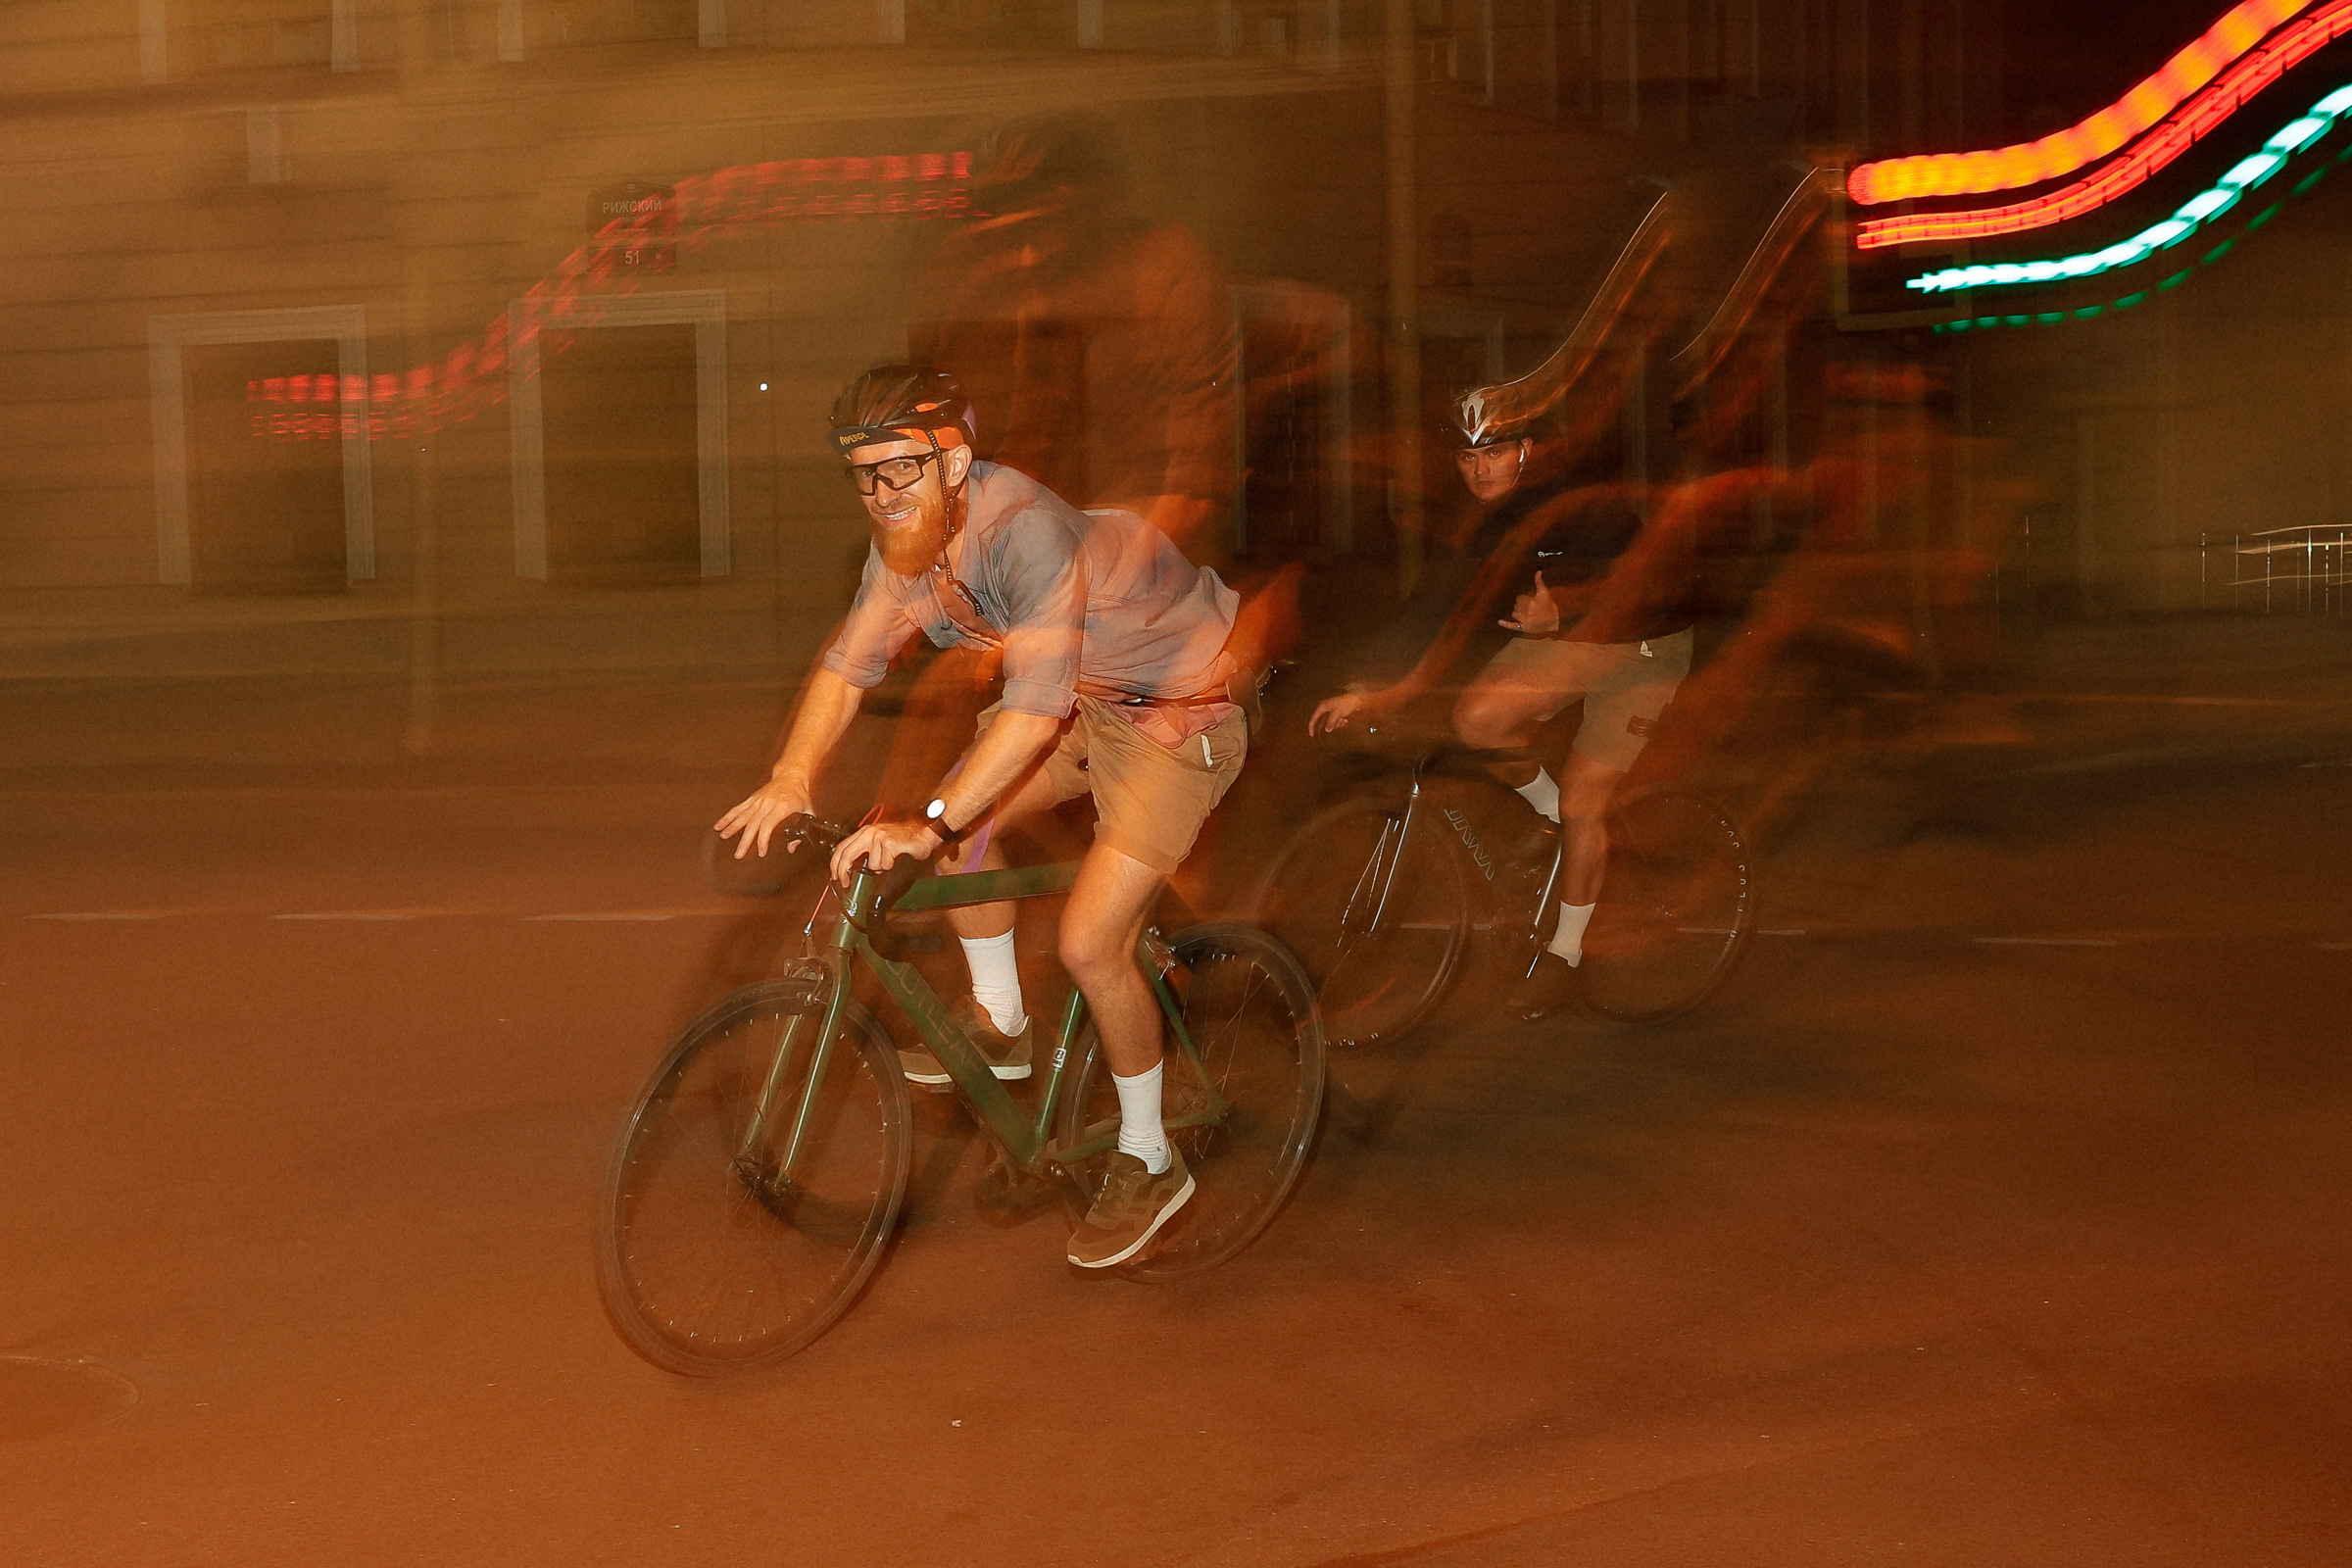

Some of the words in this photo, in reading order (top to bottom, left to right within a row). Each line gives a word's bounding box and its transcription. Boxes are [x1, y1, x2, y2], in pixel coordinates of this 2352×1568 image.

[603, 197, 662, 214] РИЖСКИЙ
[624, 250, 640, 266] 51
[839, 431, 870, 446] APEROL
